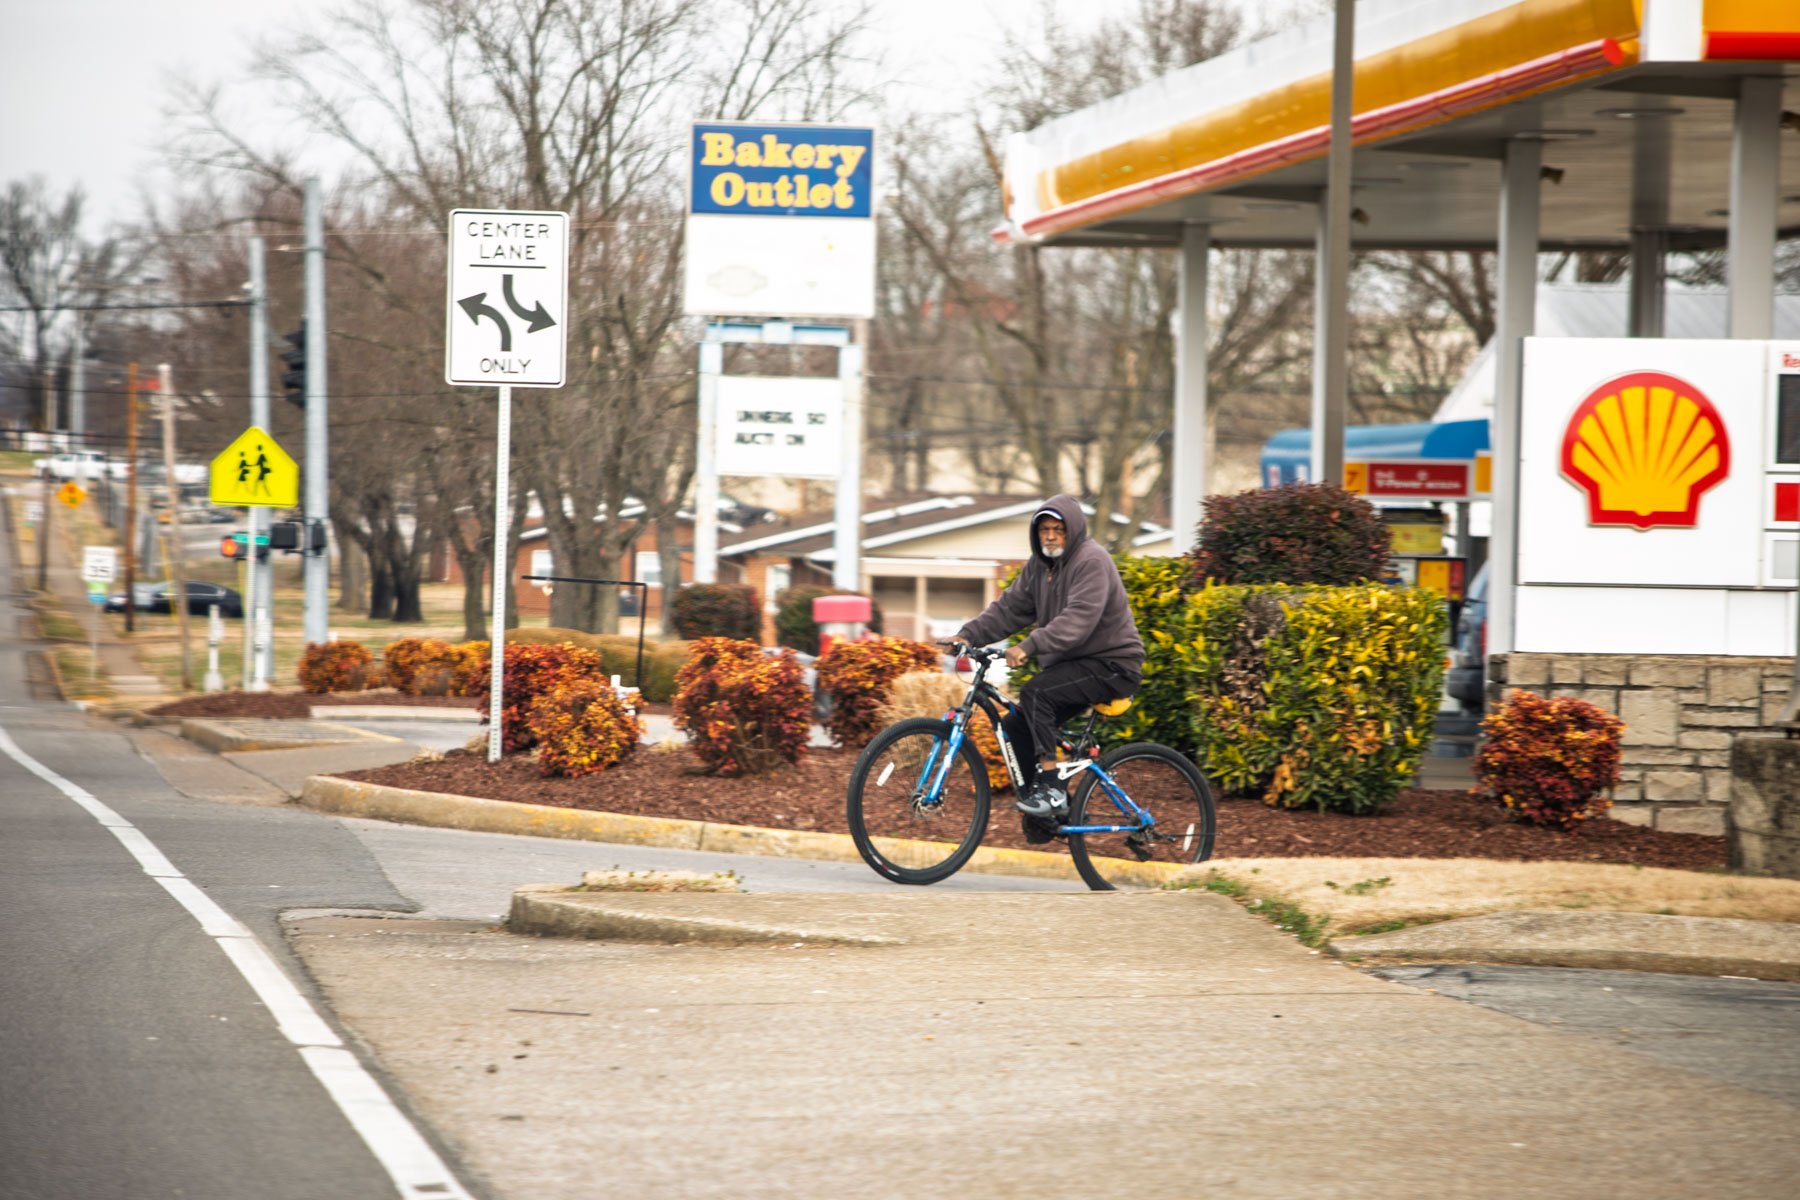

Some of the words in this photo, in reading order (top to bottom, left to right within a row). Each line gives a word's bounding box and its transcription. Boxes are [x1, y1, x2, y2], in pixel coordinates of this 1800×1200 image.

[701, 132, 866, 178] Bakery
[710, 172, 855, 209] Outlet
[467, 222, 549, 239] CENTER
[480, 244, 536, 260] LANE
[480, 358, 531, 374] ONLY
